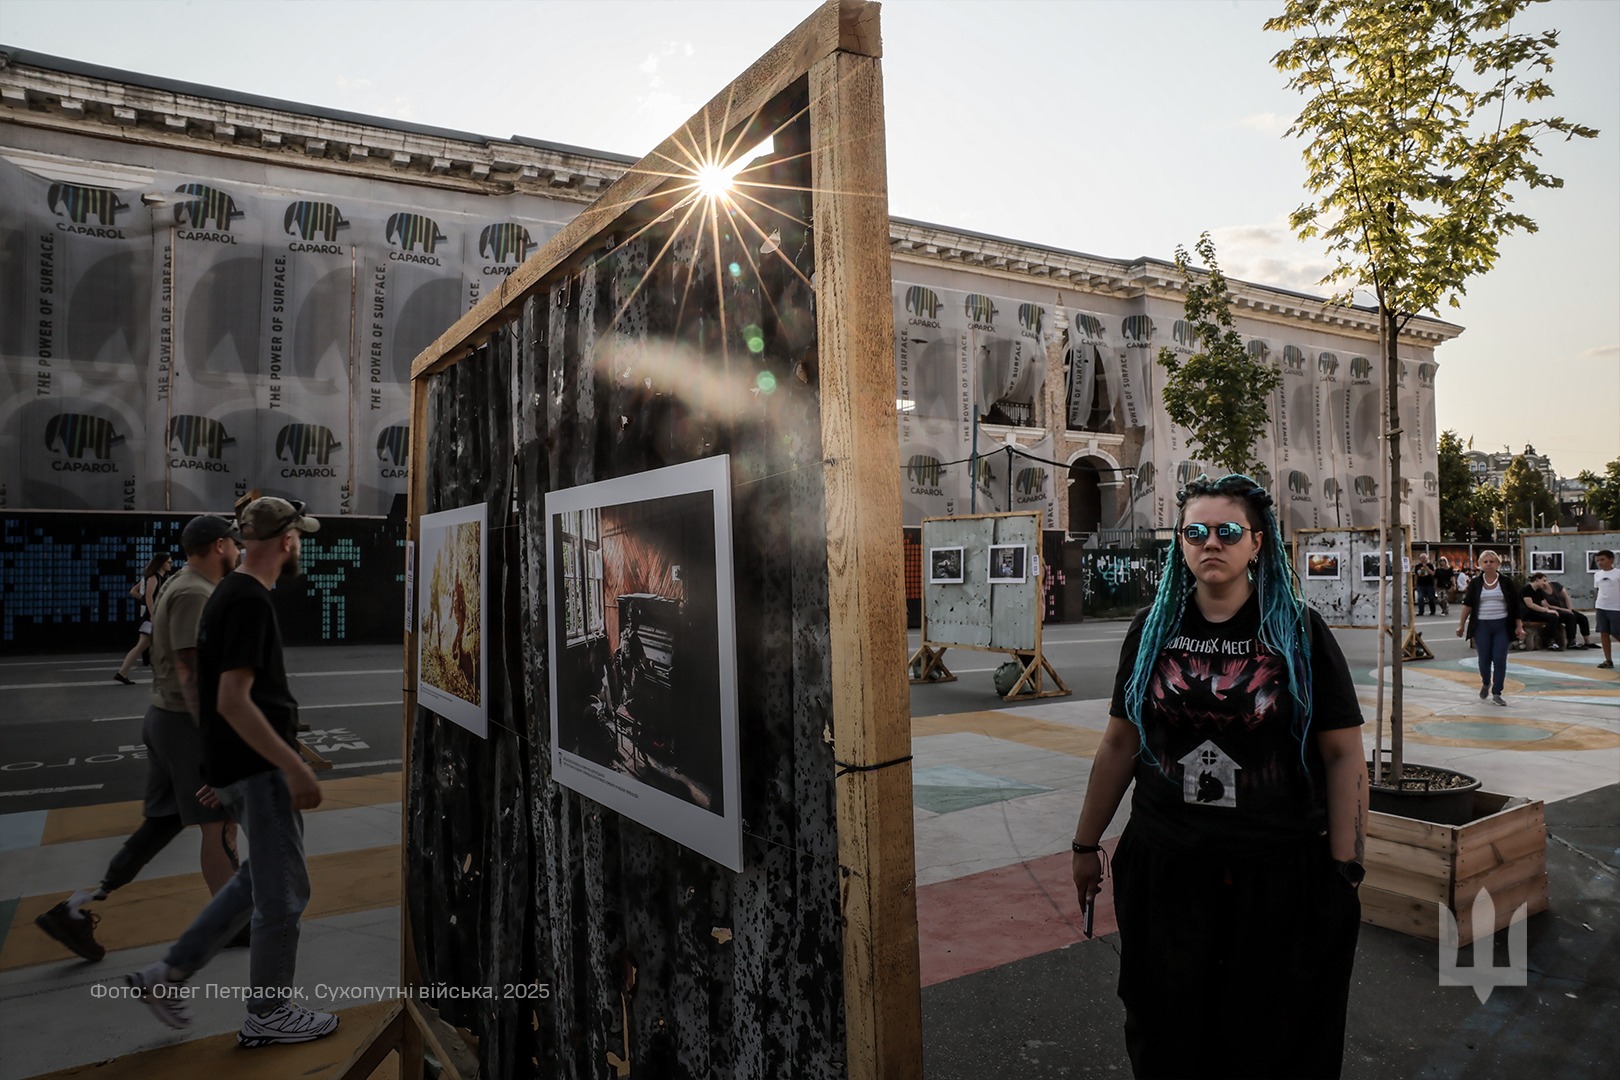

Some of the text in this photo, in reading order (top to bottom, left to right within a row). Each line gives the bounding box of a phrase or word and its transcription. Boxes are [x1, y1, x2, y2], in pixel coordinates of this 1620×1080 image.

[56, 222, 126, 239] CAPAROL
[176, 230, 237, 245] CAPAROL
[288, 242, 343, 255] CAPAROL
[388, 251, 441, 267] CAPAROL
[469, 278, 480, 310] ACE.
[37, 232, 54, 396] THE POWER OF SURFACE.
[161, 306, 171, 322] OF
[908, 318, 942, 329] CAPAROL
[967, 323, 997, 333] CAPAROL
[269, 254, 286, 409] THE POWER OF SURFACE.
[370, 262, 386, 411] THE POWER OF SURFACE.
[159, 327, 171, 371] POWER
[158, 374, 169, 401] THE
[901, 376, 908, 387] OF
[962, 380, 969, 389] OF
[1126, 390, 1133, 400] OF
[902, 389, 910, 422] POER
[962, 392, 970, 422] POWER
[1282, 410, 1287, 420] OF
[1316, 419, 1321, 428] OF
[1345, 421, 1350, 429] OF
[51, 460, 119, 473] CAPAROL
[170, 458, 230, 473] CAPAROL
[280, 468, 337, 478] CAPAROL
[910, 486, 944, 497] CAPAROL
[970, 482, 994, 500] CPAROL
[1016, 493, 1048, 504] CAPAROL
[1221, 638, 1252, 655] МЕСТ
